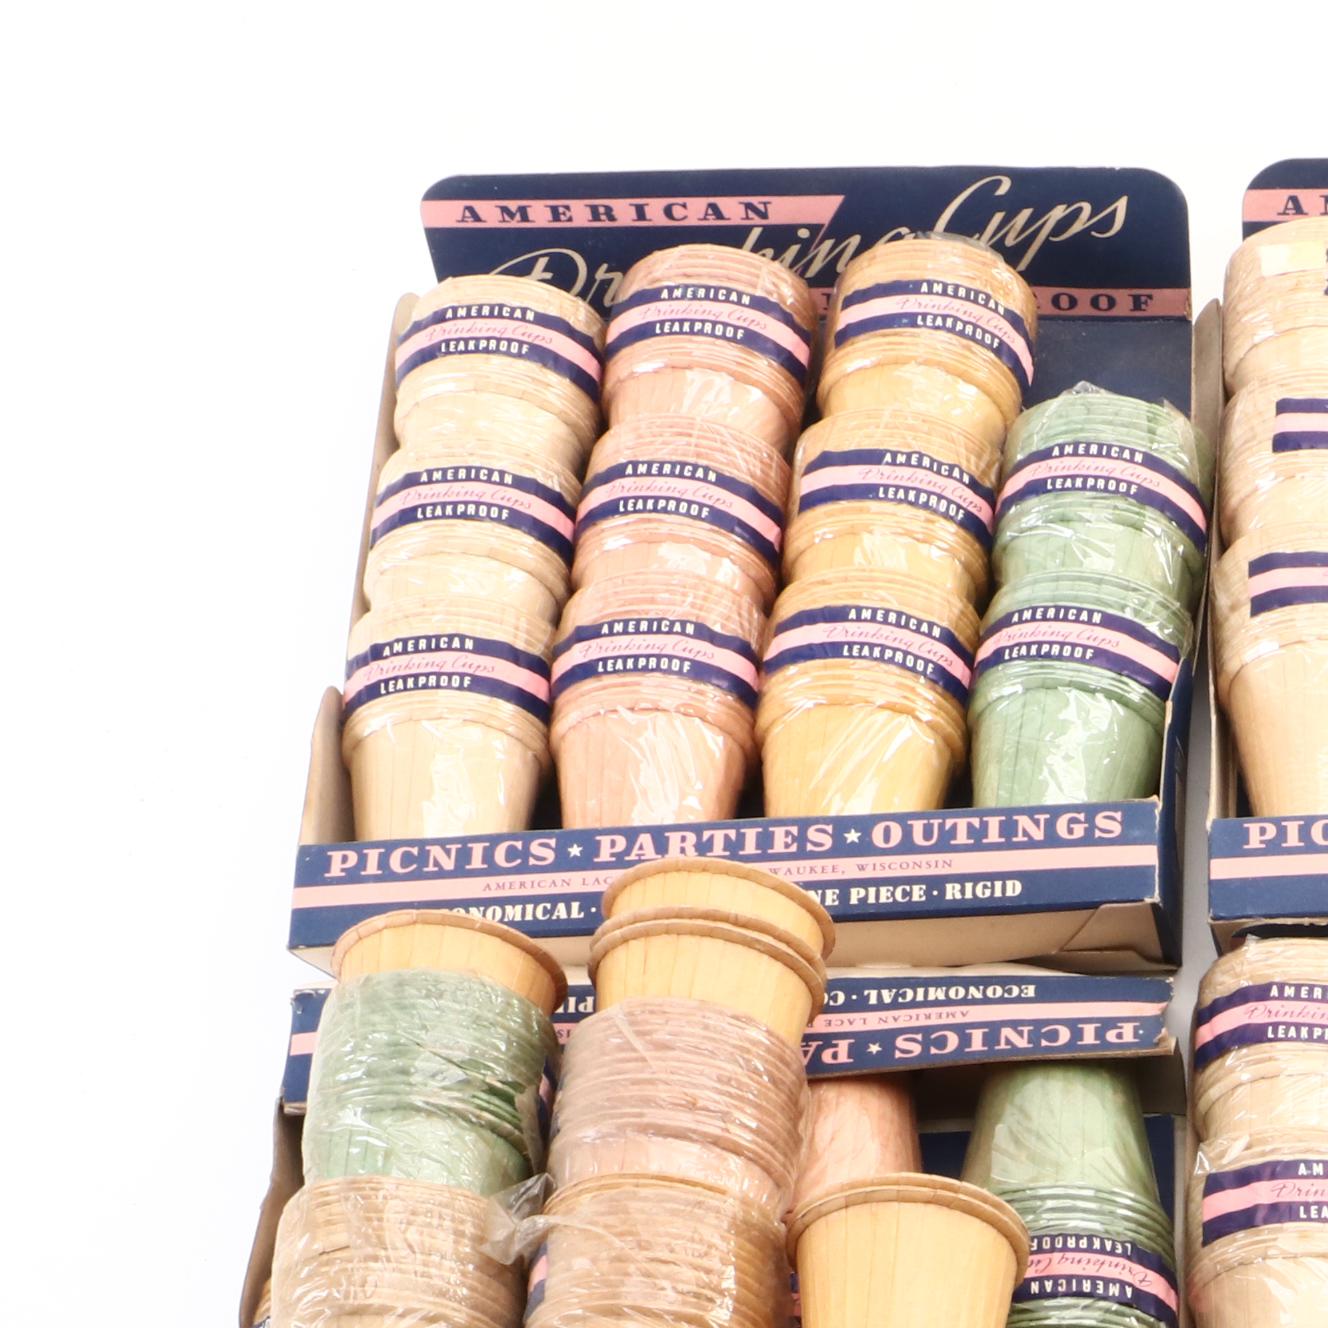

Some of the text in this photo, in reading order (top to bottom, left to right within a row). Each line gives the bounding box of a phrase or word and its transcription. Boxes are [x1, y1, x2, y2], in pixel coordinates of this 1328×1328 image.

[456, 201, 772, 223] AMERICAN
[933, 175, 1128, 271] Cups
[445, 306, 535, 322] AMERICAN
[441, 339, 530, 354] LEAKPROOF
[1052, 445, 1144, 463] AMERICAN
[625, 464, 716, 482] AMERICAN
[1047, 478, 1138, 495] LEAKPROOF
[620, 499, 709, 517] LEAKPROOF
[602, 621, 695, 635] AMERICAN
[598, 658, 691, 673] LEAKPROOF
[324, 811, 1123, 878] PICNICS PARTIES OUTINGS
[483, 860, 953, 891] AMERICAN WISCONSIN
[849, 880, 1022, 905] PIECE RIGID
[864, 984, 1036, 1005] ECONOMICAL
[824, 1010, 969, 1026] AMERICAN LACE
[894, 1022, 1140, 1058] PICNICS
